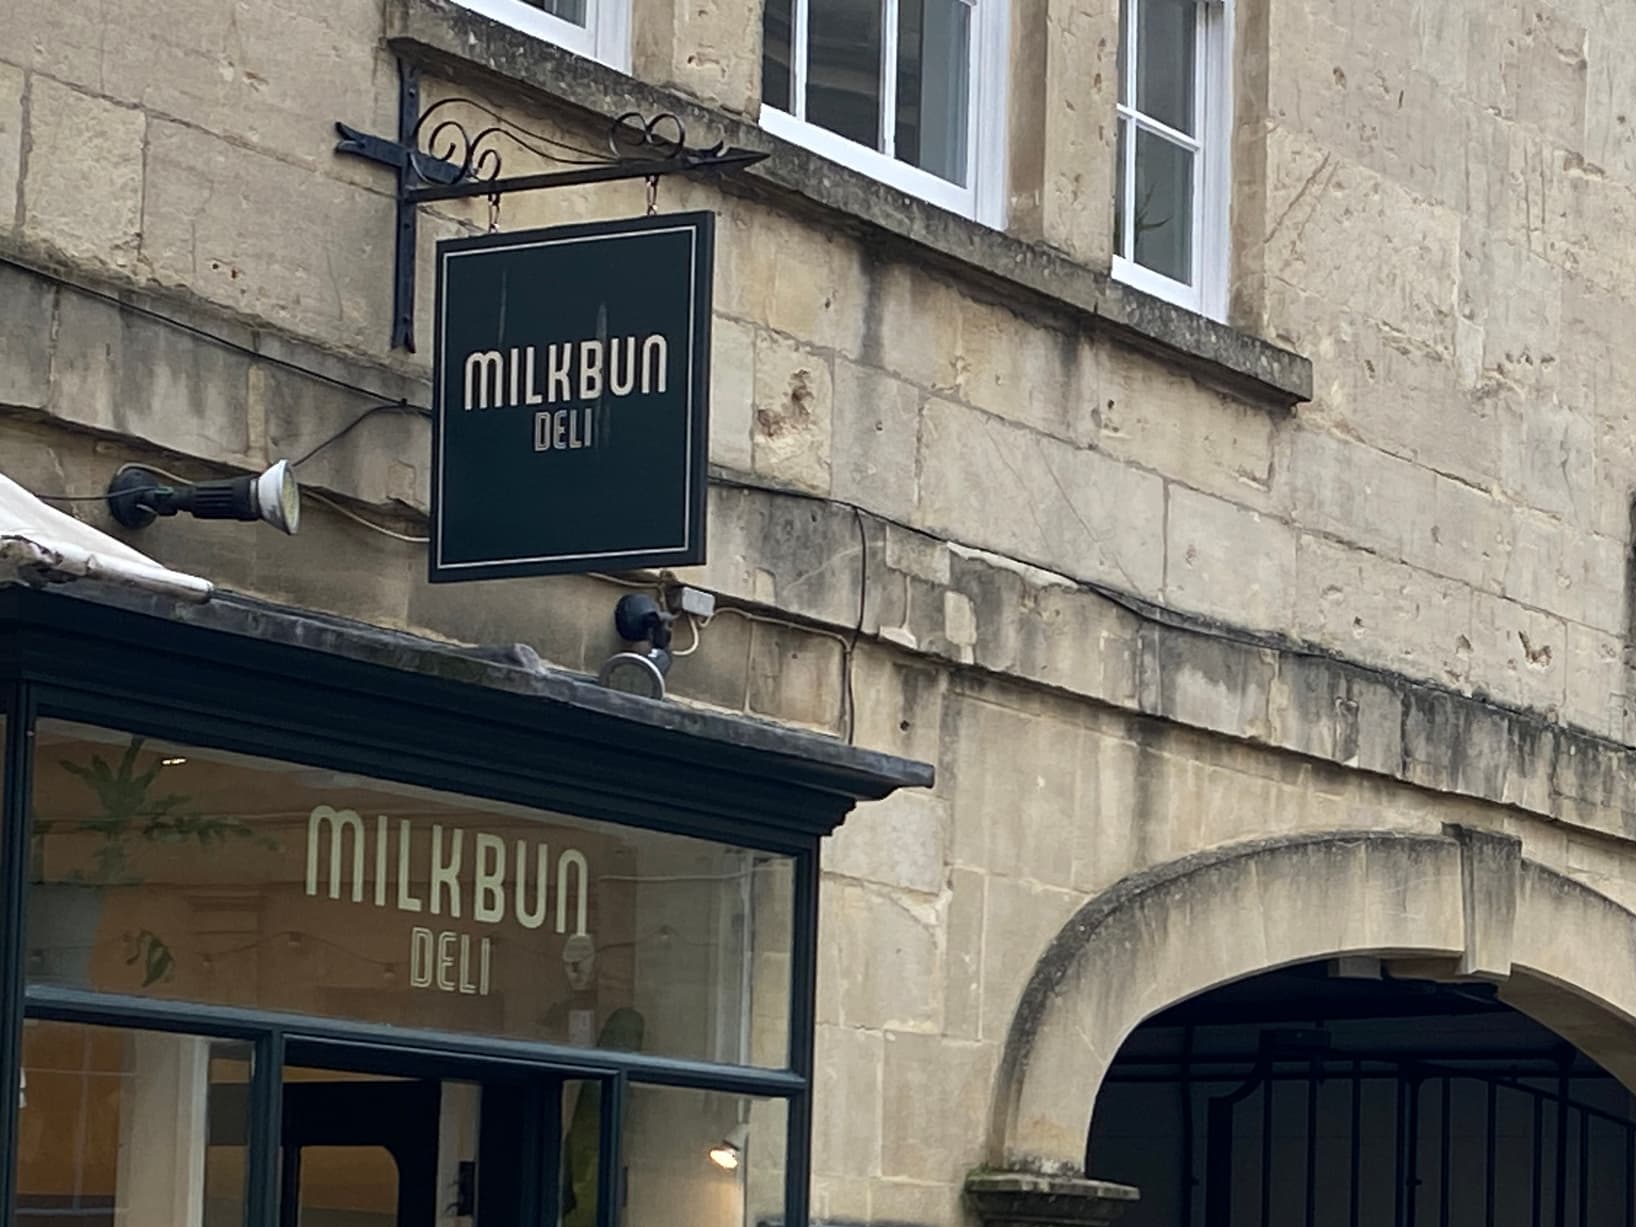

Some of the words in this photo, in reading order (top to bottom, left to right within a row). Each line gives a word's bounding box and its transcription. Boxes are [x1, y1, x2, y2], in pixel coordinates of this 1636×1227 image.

[464, 333, 668, 411] MILKBUN
[534, 408, 592, 452] DELI
[305, 804, 589, 937] MILKBUN
[410, 926, 491, 996] DELI
